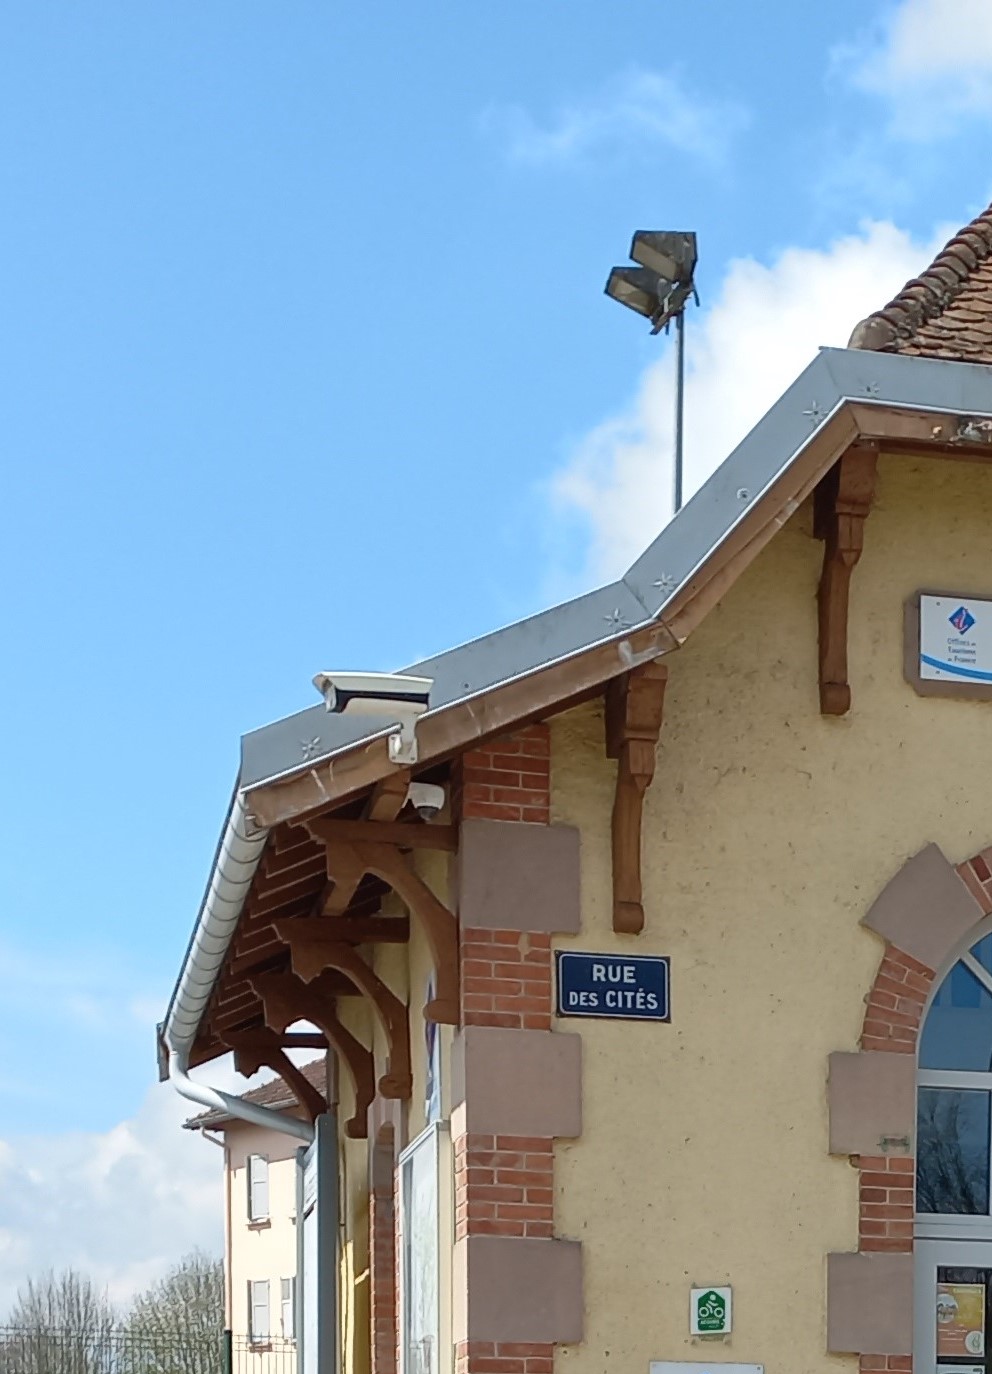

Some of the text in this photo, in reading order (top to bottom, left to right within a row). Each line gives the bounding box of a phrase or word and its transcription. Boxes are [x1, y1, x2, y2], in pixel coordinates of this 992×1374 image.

[592, 963, 637, 983] RUE
[569, 988, 658, 1010] DES CITÉS
